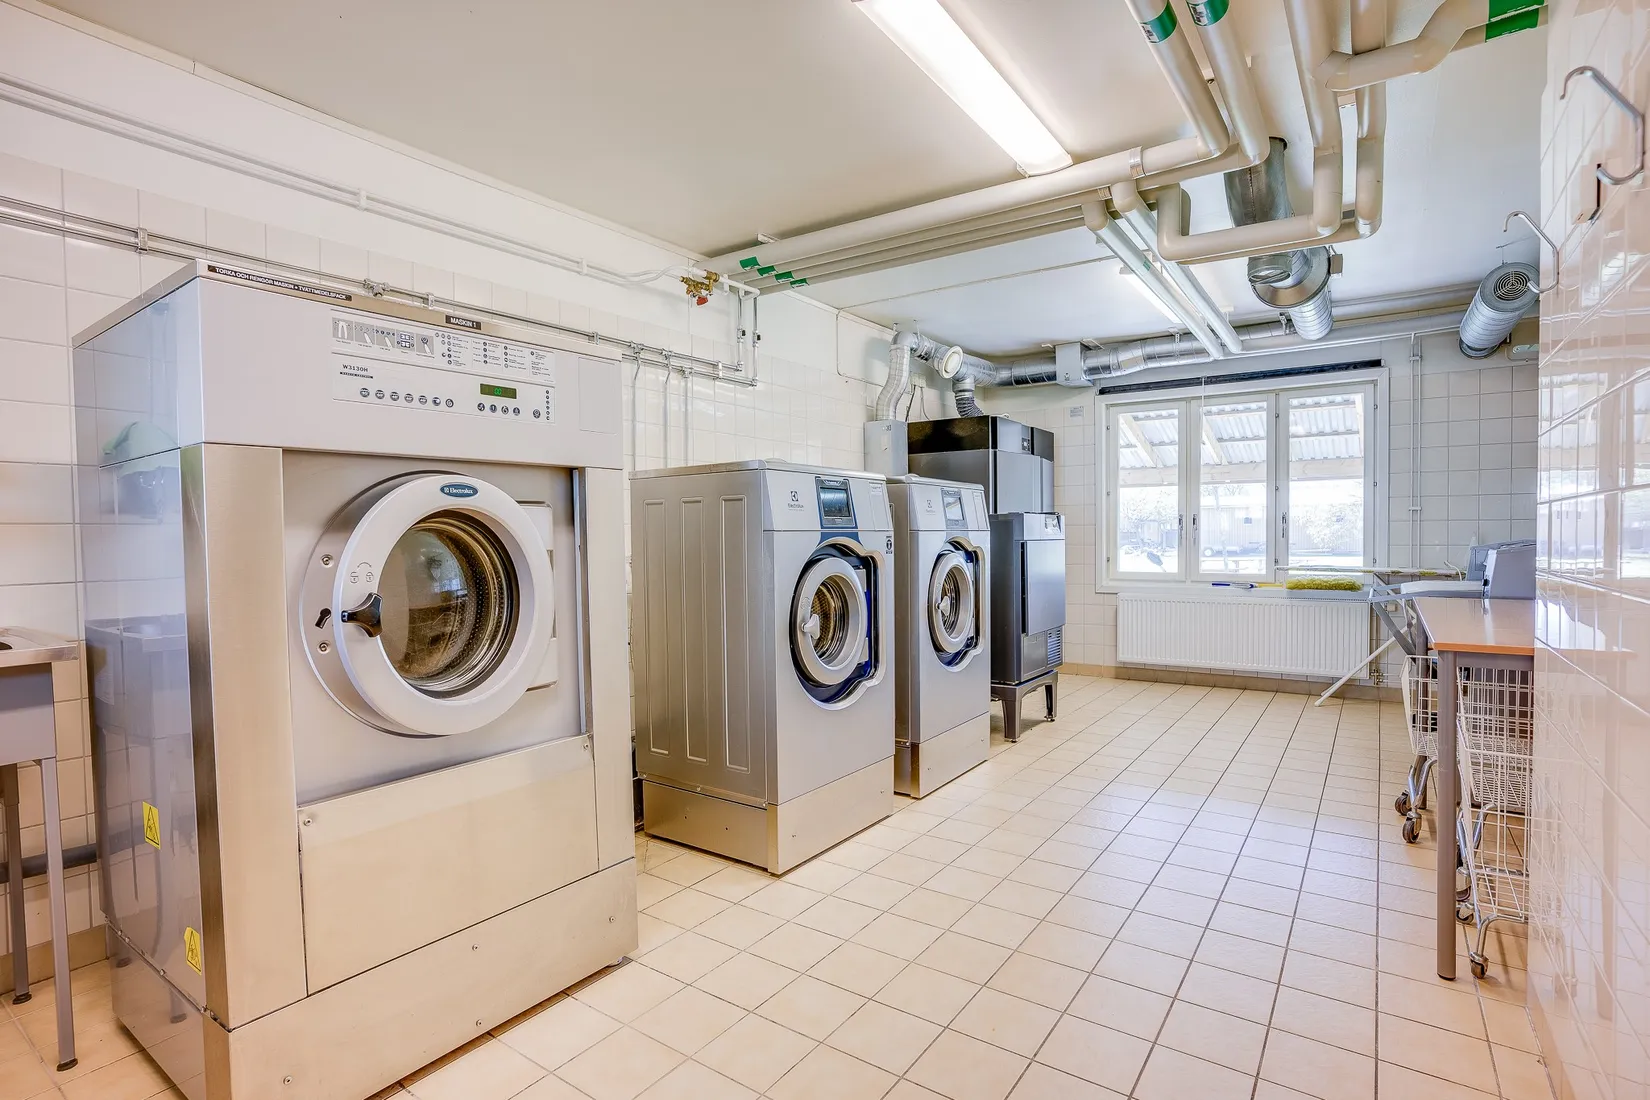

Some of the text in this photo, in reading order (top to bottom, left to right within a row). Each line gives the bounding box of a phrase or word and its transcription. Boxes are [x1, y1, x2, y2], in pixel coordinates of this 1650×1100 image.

[215, 267, 237, 277] TORKA
[236, 271, 249, 280] OCH
[450, 316, 473, 328] MASKIN
